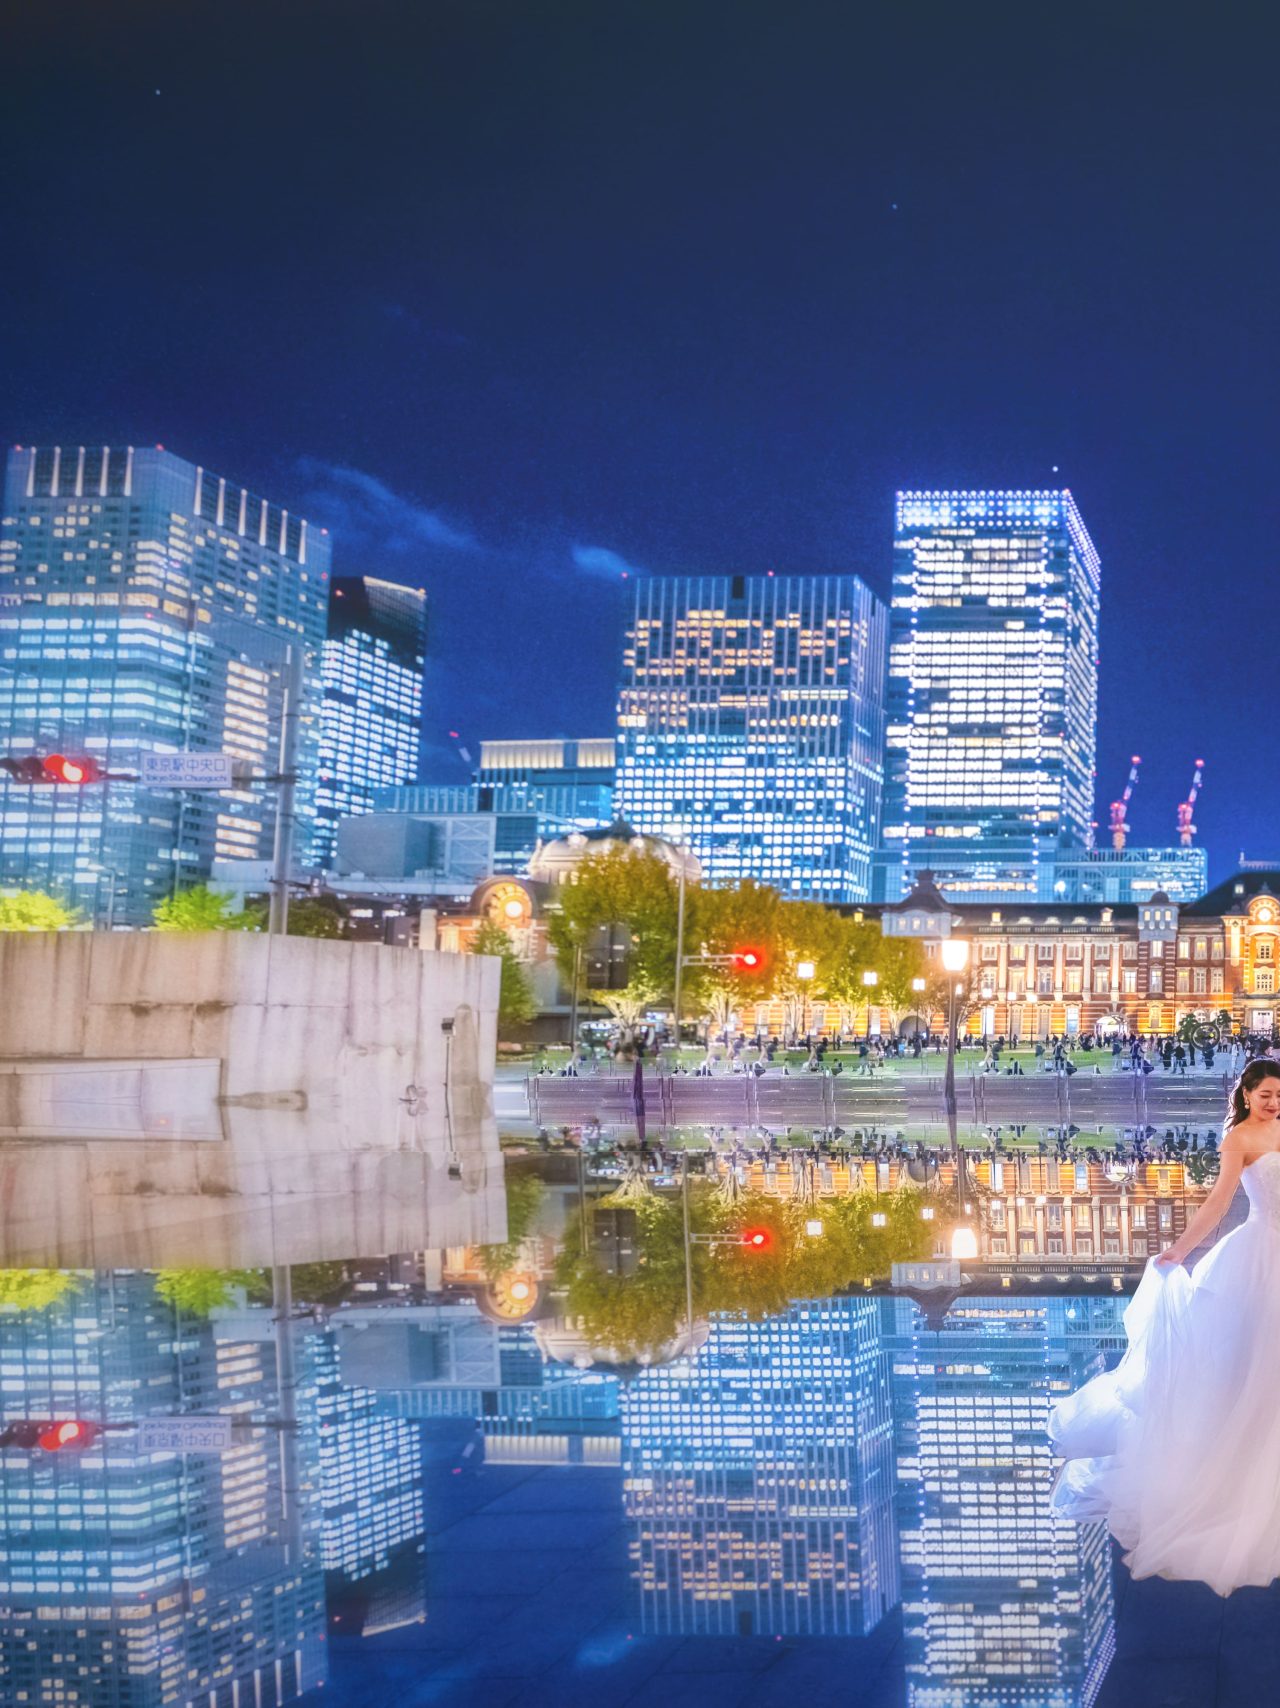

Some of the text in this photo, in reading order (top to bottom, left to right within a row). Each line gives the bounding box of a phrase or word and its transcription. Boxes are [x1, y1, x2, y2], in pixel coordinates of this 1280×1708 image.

[146, 758, 226, 772] 東京駅中央口
